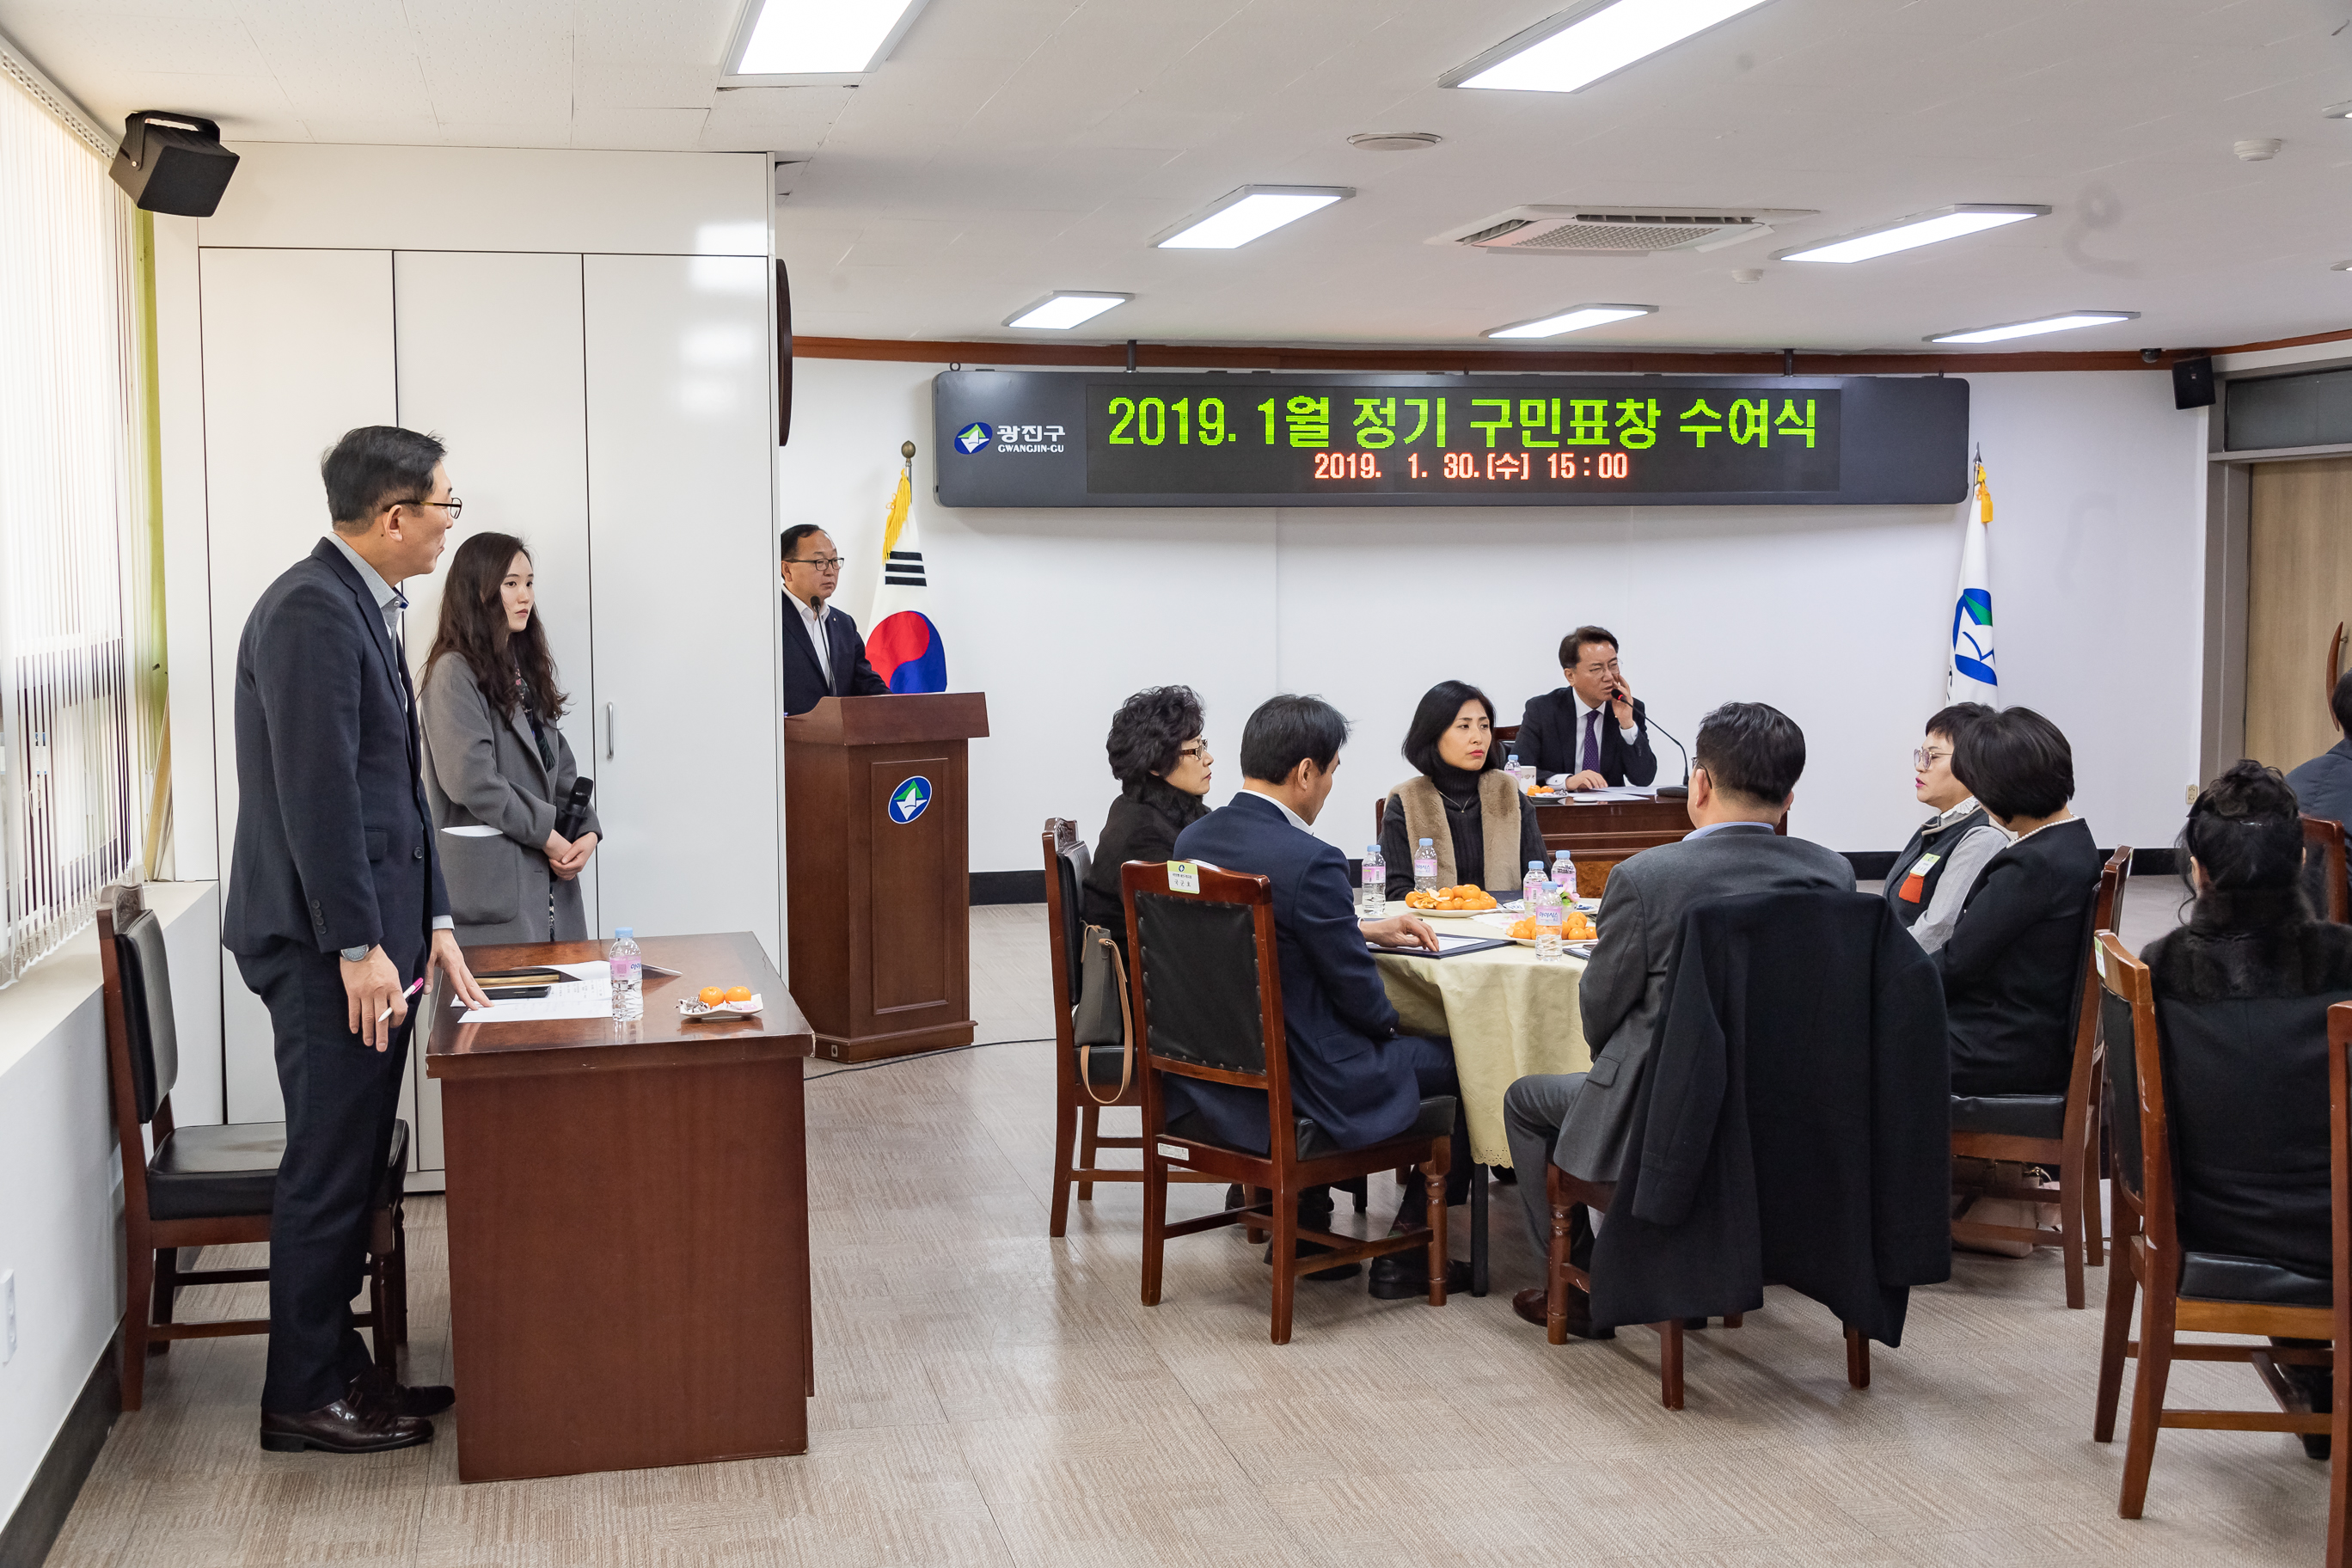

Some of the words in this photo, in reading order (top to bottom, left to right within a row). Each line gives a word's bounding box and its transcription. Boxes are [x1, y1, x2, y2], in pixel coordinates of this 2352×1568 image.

[996, 425, 1066, 444] 광진구
[1108, 396, 1236, 446] 2019.
[1257, 395, 1330, 448] 1월
[1352, 396, 1447, 450] 정기
[1469, 397, 1662, 450] 구민표창
[1679, 398, 1816, 449] 수여식
[997, 444, 1064, 453] GWANGJIN-GU
[1314, 451, 1382, 481] 2019.
[1407, 451, 1429, 480] 1.
